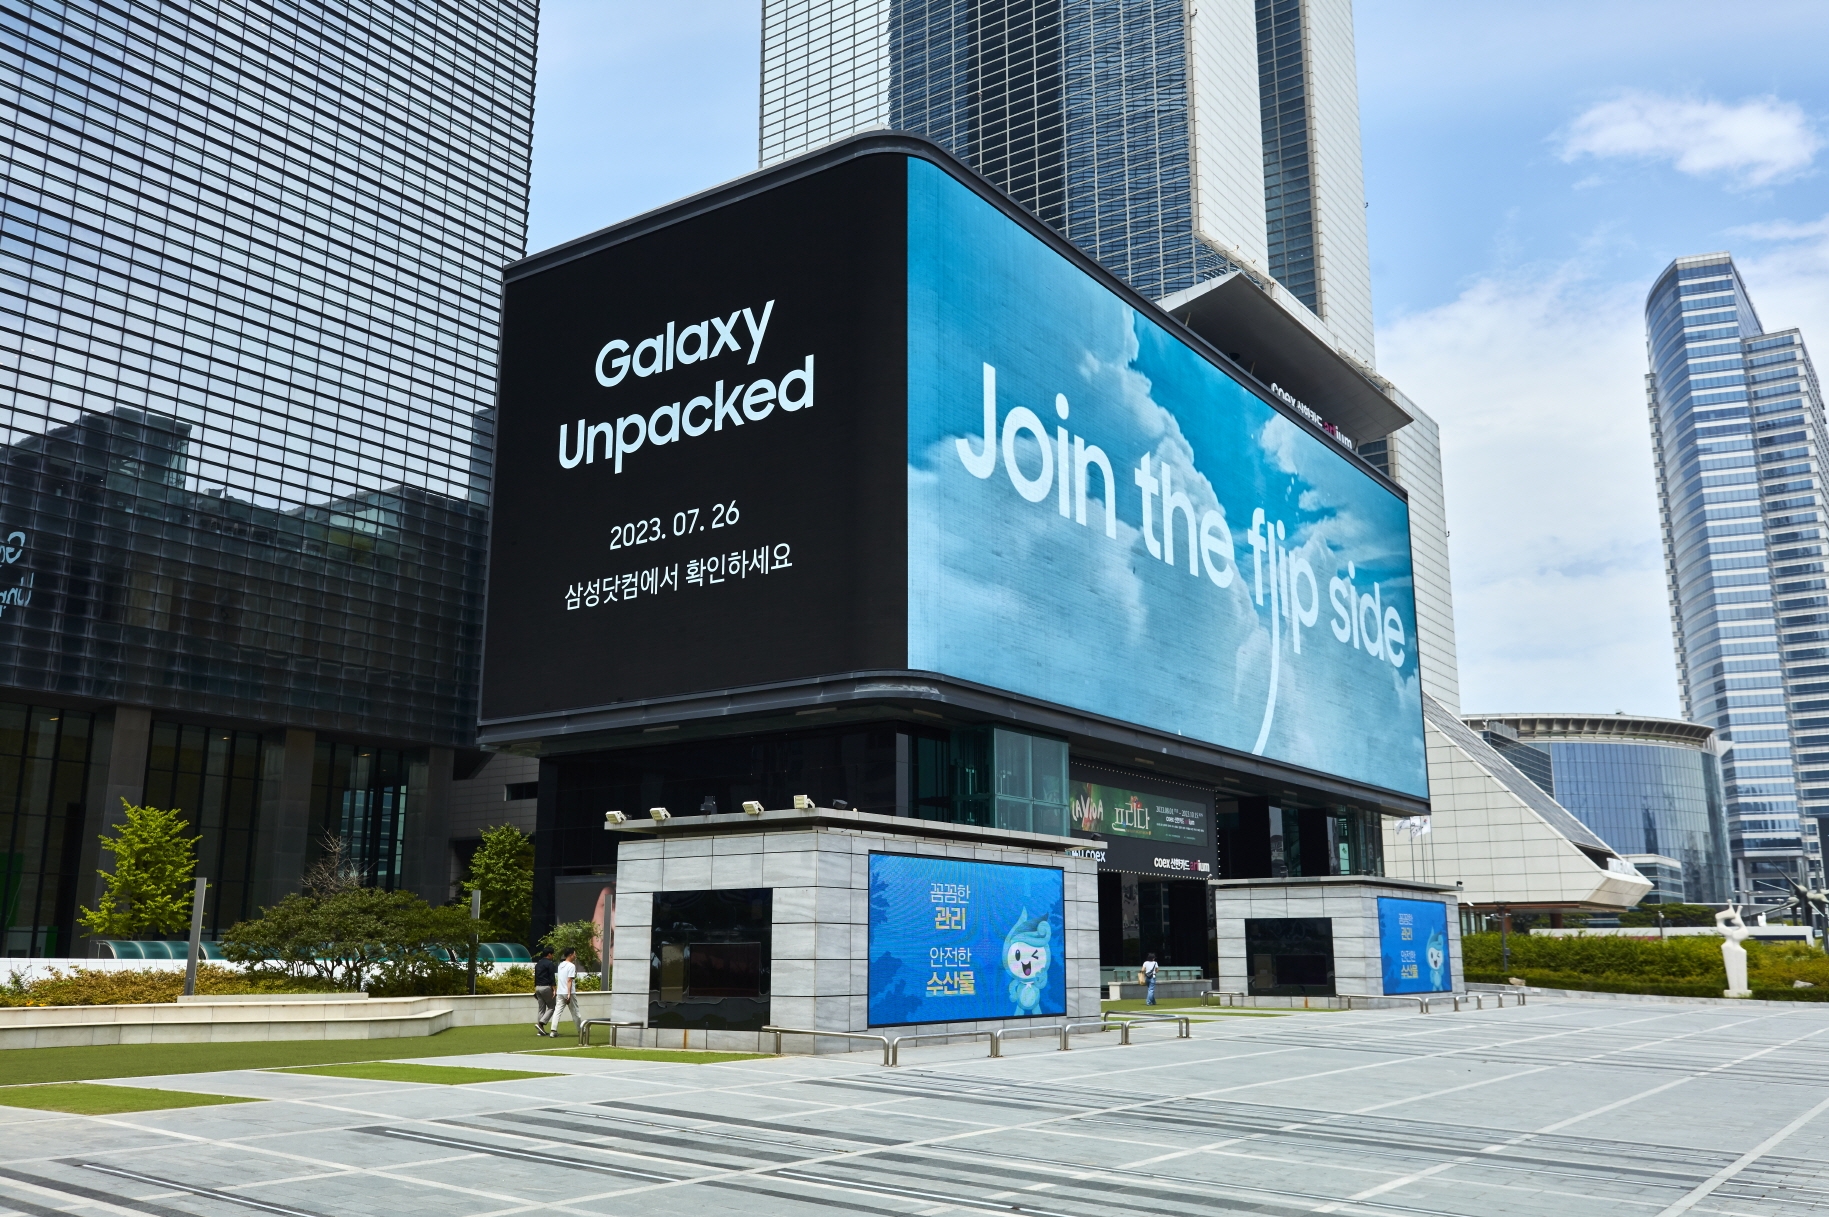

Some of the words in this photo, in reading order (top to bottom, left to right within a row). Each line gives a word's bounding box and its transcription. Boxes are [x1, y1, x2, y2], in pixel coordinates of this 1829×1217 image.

[595, 299, 775, 388] Galaxy
[558, 354, 814, 474] Unpacked
[609, 517, 666, 550] 2023.
[672, 508, 705, 537] 07.
[711, 500, 740, 529] 26
[564, 563, 679, 610] 삼성닷컴에서
[685, 542, 793, 587] 확인하세요
[955, 362, 1117, 539] Join
[1134, 451, 1235, 588] the
[1247, 507, 1319, 756] flip
[1329, 561, 1406, 667] side
[1153, 857, 1170, 869] coex
[1190, 859, 1210, 872] artium
[930, 883, 971, 904] 꼼꼼한
[934, 906, 966, 930] 관리
[929, 947, 972, 968] 안전한
[926, 970, 975, 996] 수산물
